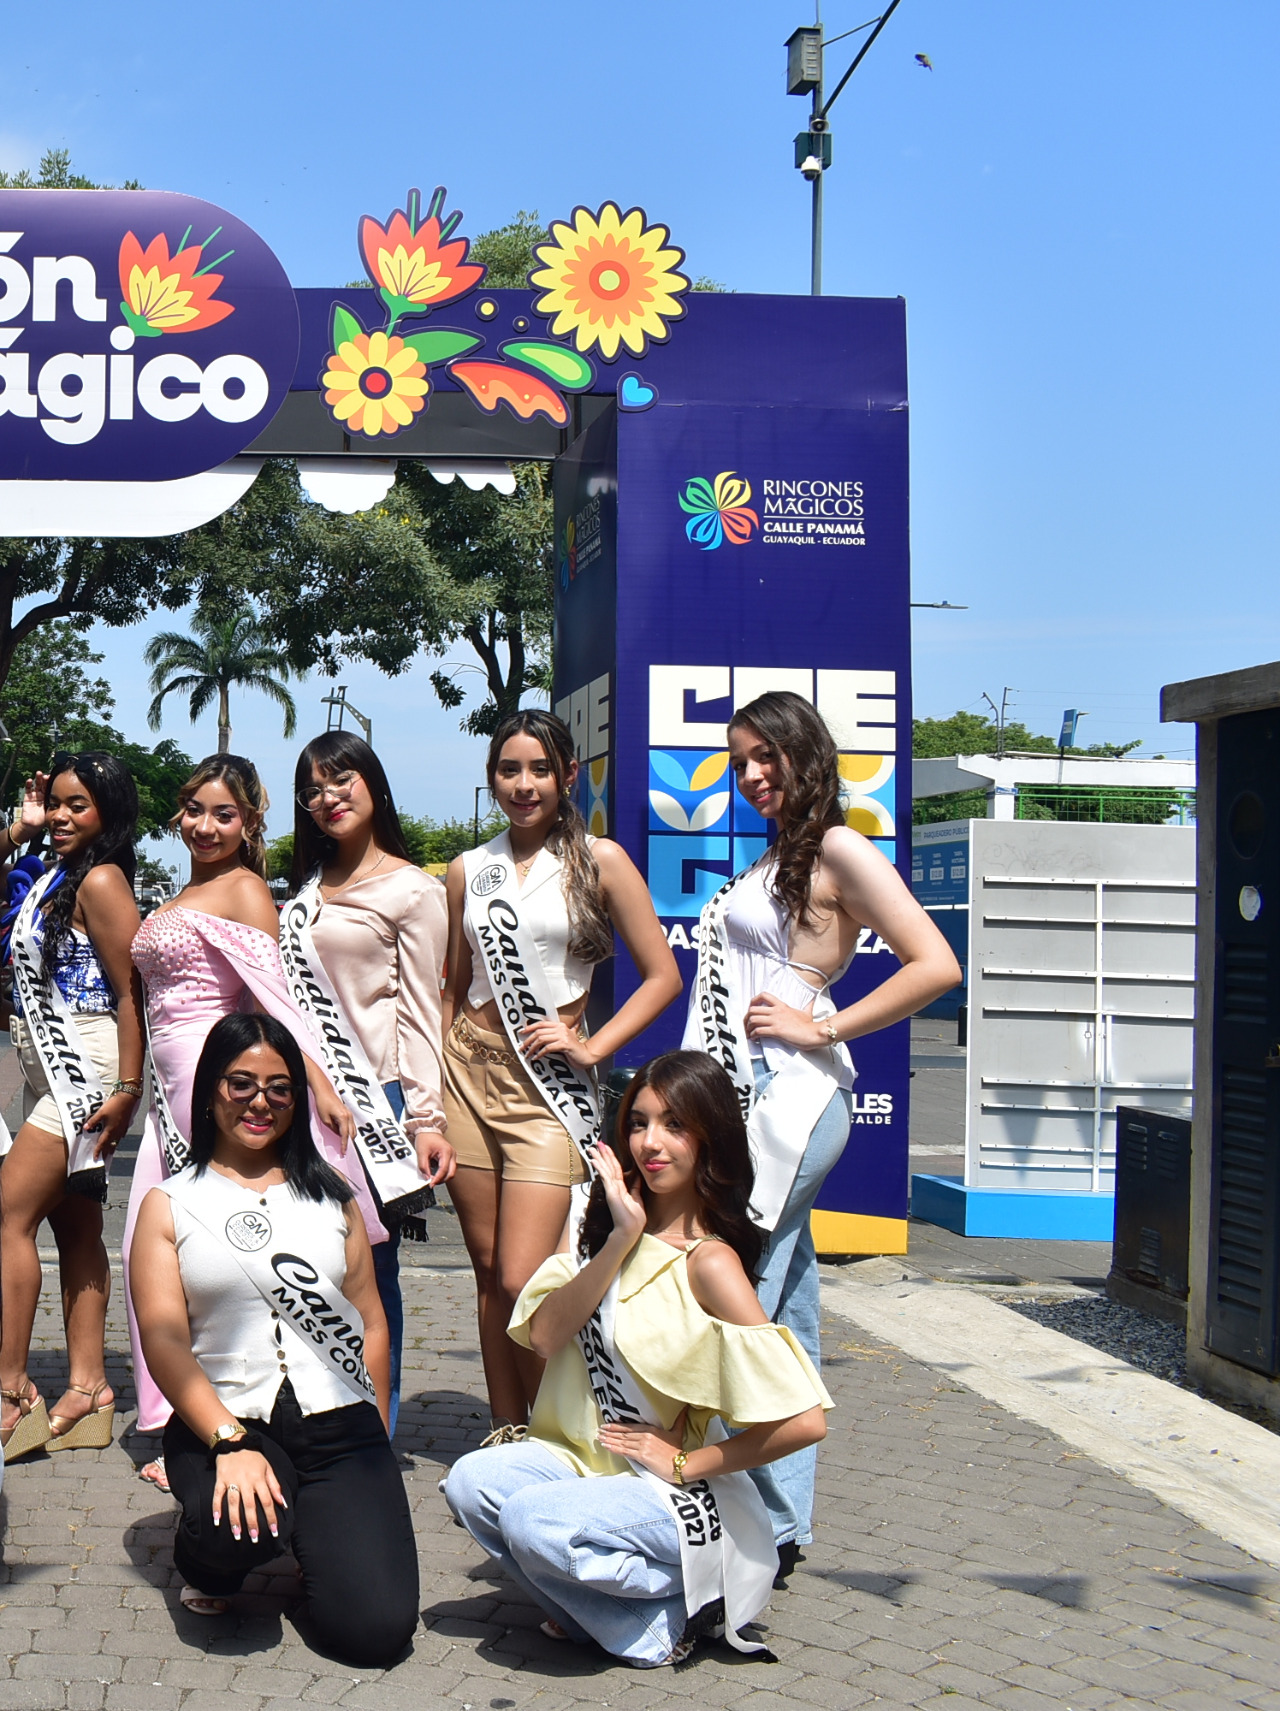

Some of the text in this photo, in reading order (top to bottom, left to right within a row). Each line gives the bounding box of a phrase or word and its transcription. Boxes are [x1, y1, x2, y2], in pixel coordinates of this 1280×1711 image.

[763, 479, 864, 498] RINCONES
[763, 520, 864, 534] CALLE PANAMÁ
[763, 535, 815, 545] GUAYAQUIL
[822, 537, 866, 545] ECUADOR
[555, 672, 609, 762] AE
[478, 925, 507, 986] MISS
[287, 902, 375, 1115] Candidata
[501, 992, 569, 1117] COLGIAL
[358, 1123, 394, 1165] 2027
[375, 1117, 412, 1160] 2026
[243, 1214, 268, 1240] GM
[271, 1286, 328, 1345] MISS
[670, 1492, 706, 1547] 2027
[688, 1478, 723, 1542] 2026
